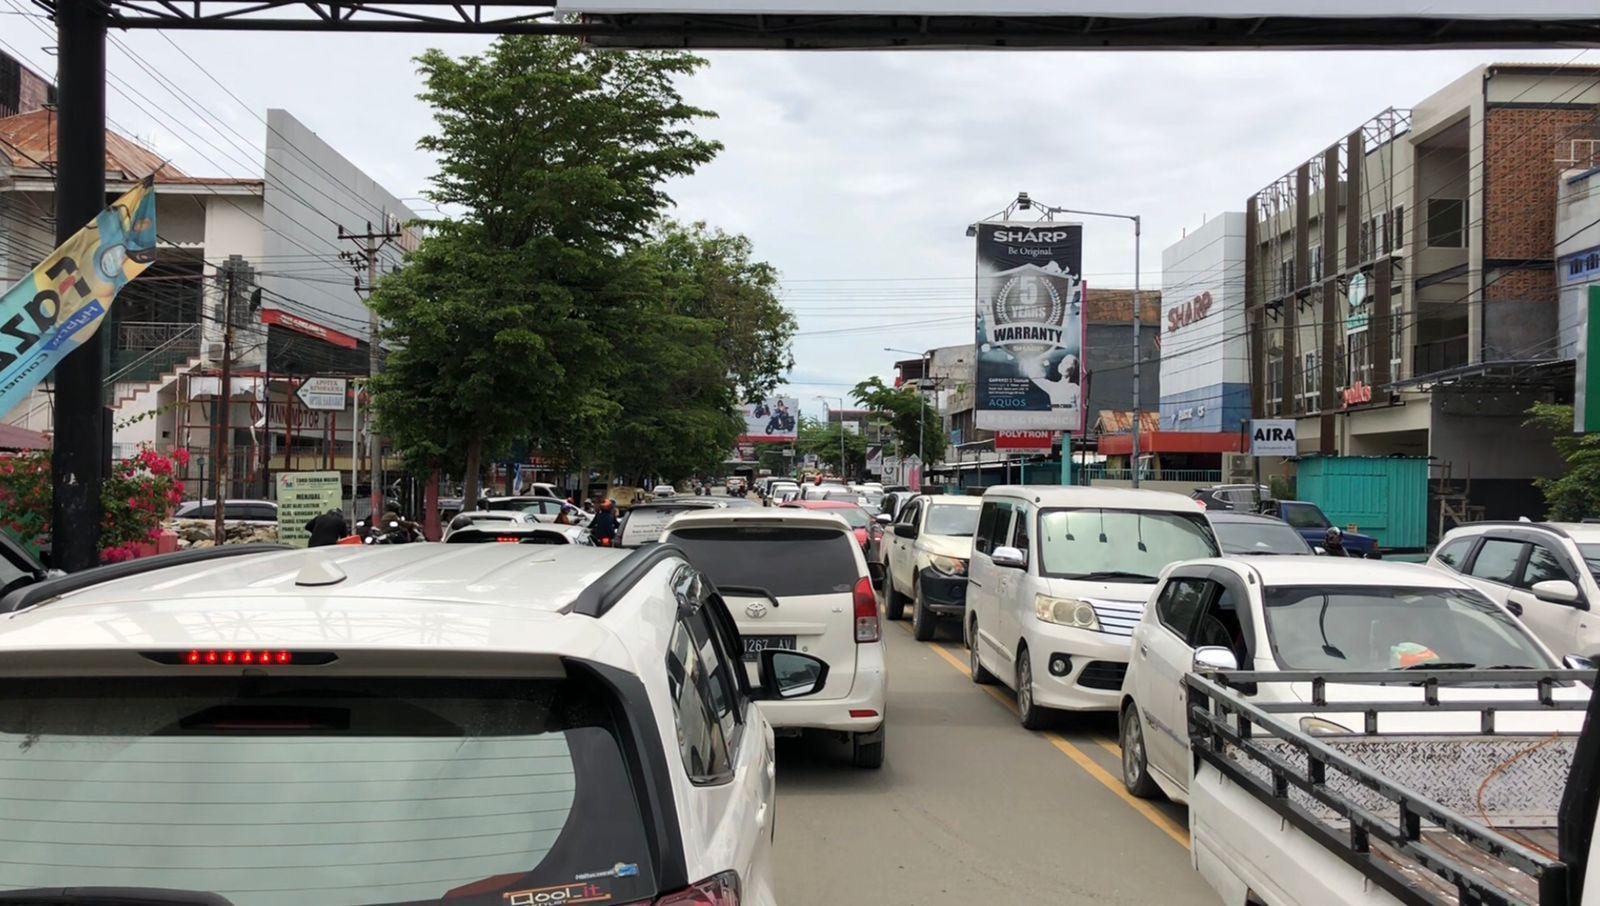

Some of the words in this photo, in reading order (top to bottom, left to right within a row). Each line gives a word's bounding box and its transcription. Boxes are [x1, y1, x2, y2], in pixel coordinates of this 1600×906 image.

[992, 231, 1068, 243] SHARP
[1008, 247, 1019, 256] Be
[1019, 275, 1038, 304] 5
[1011, 305, 1047, 320] YEARS
[1168, 291, 1213, 331] SHARP
[993, 327, 1064, 345] WARRANTY
[988, 398, 1027, 408] AQUOS
[998, 430, 1049, 439] POLYTRON
[1254, 427, 1296, 441] AIRA
[743, 639, 768, 653] 1267
